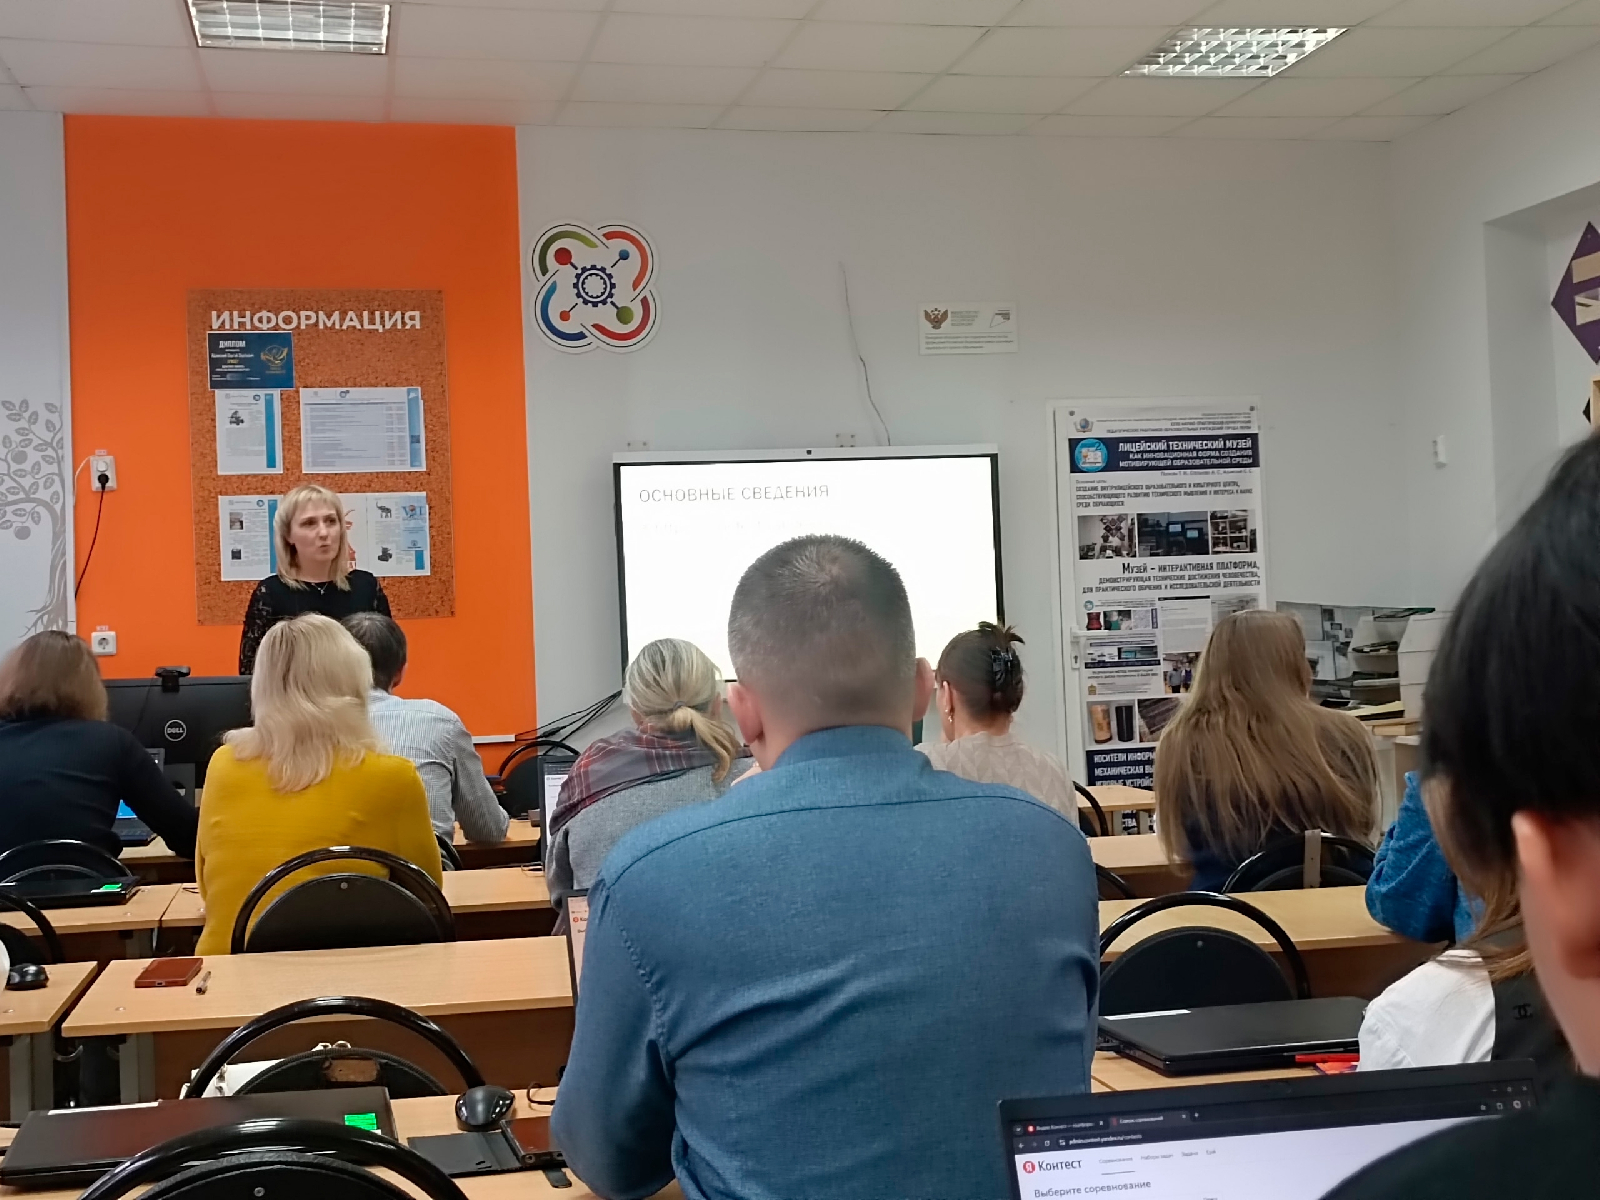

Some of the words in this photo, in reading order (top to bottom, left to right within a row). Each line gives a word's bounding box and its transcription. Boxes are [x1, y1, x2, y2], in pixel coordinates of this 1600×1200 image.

[211, 310, 421, 332] ИНФОРМАЦИЯ
[219, 340, 246, 348] ДИПЛОМ
[1118, 440, 1167, 452] ЛИЦЕЙСКИЙ
[1168, 438, 1224, 451] ТЕХНИЧЕСКИЙ
[1226, 437, 1252, 449] МУЗЕЙ
[1143, 450, 1197, 459] ИННОВАЦИОННАЯ
[1119, 459, 1172, 467] МОТИВИРУЮЩЕЙ
[1172, 457, 1231, 466] ОБРАЗОВАТЕЛЬНОЙ
[639, 487, 735, 502] ОСНОВНЫЕ
[741, 485, 829, 501] СВЕДЕНИЯ
[1094, 753, 1127, 763] НОСИТЕЛИ
[1127, 752, 1155, 761] ИНФОРМ
[1094, 765, 1144, 776] МЕХАНИЧЕСКАЯ
[1125, 776, 1153, 787] УСТРОЙС
[1038, 1159, 1082, 1172] Контест
[1034, 1187, 1082, 1198] Выберите
[1084, 1181, 1151, 1194] соревнование
